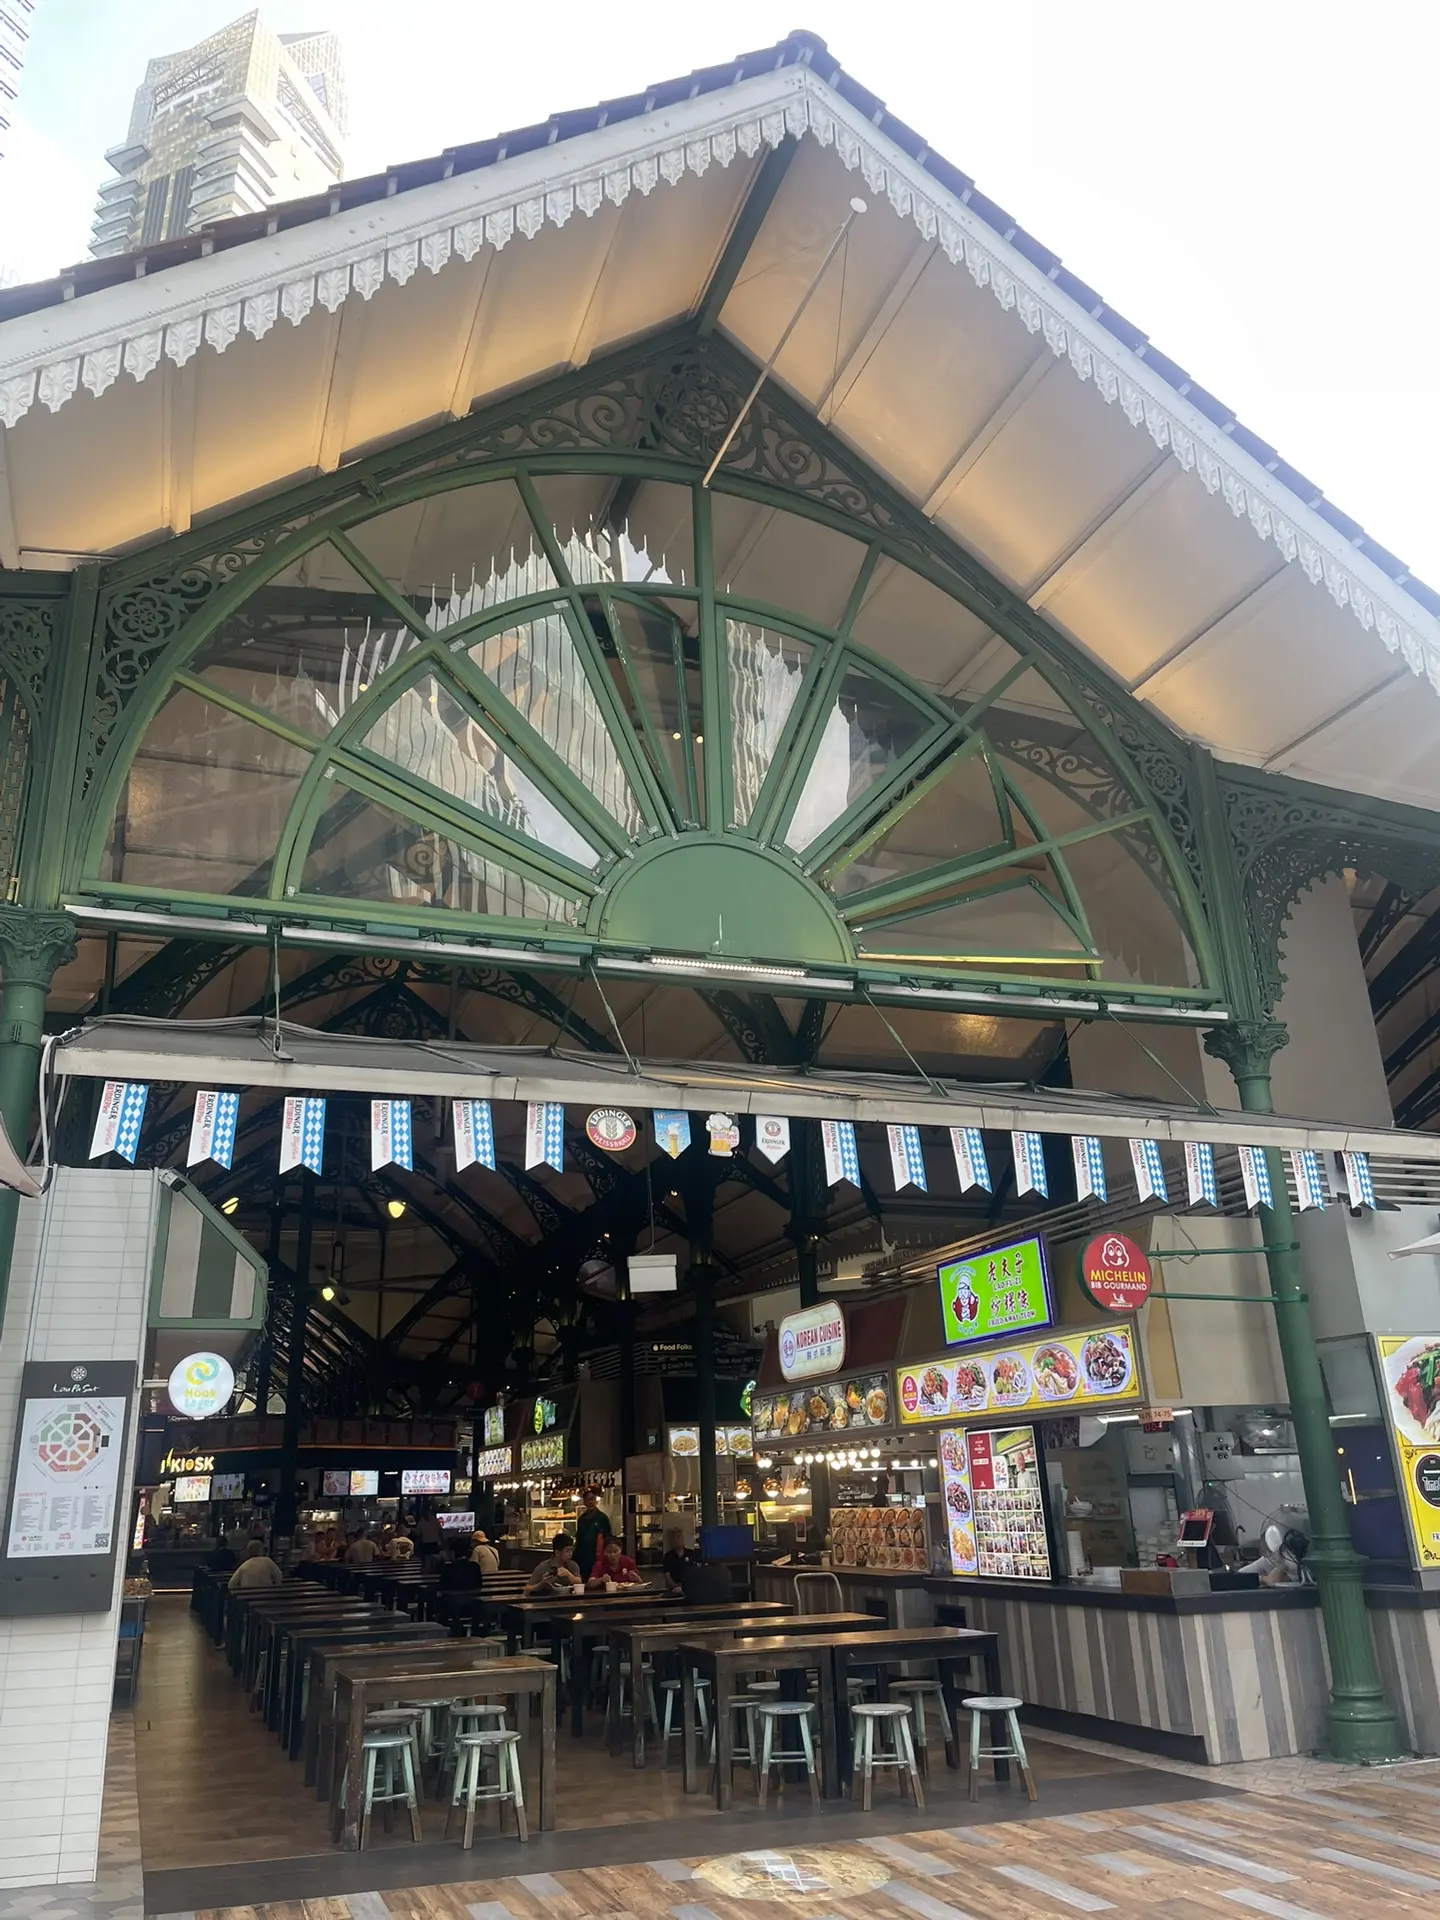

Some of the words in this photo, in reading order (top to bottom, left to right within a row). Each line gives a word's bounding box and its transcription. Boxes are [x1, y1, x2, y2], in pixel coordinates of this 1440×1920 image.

[109, 1084, 124, 1120] ERDINGER
[203, 1094, 216, 1129] ERDINGER
[292, 1100, 303, 1135] ERDINGER
[381, 1102, 390, 1135] ERDINGER
[462, 1102, 471, 1135] ERDINGER
[535, 1103, 545, 1135] ERDINGER
[590, 1109, 632, 1127] ERDINGER
[761, 1137, 786, 1146] ERDINGER
[829, 1122, 839, 1153] ERDINGER
[895, 1127, 905, 1157] ERDINGER
[988, 1252, 1023, 1282] 老夫子
[1090, 1269, 1146, 1283] MICHELIN
[993, 1282, 1005, 1291] LAO
[1090, 1281, 1102, 1289] BIB
[1103, 1281, 1147, 1291] GOURMAND
[796, 1327, 819, 1349] KOREAN
[819, 1320, 841, 1342] CUISINE
[988, 1318, 1005, 1327] FRIED
[659, 1343, 676, 1351] Food
[676, 1343, 692, 1351] Folks
[184, 1388, 217, 1398] Hook
